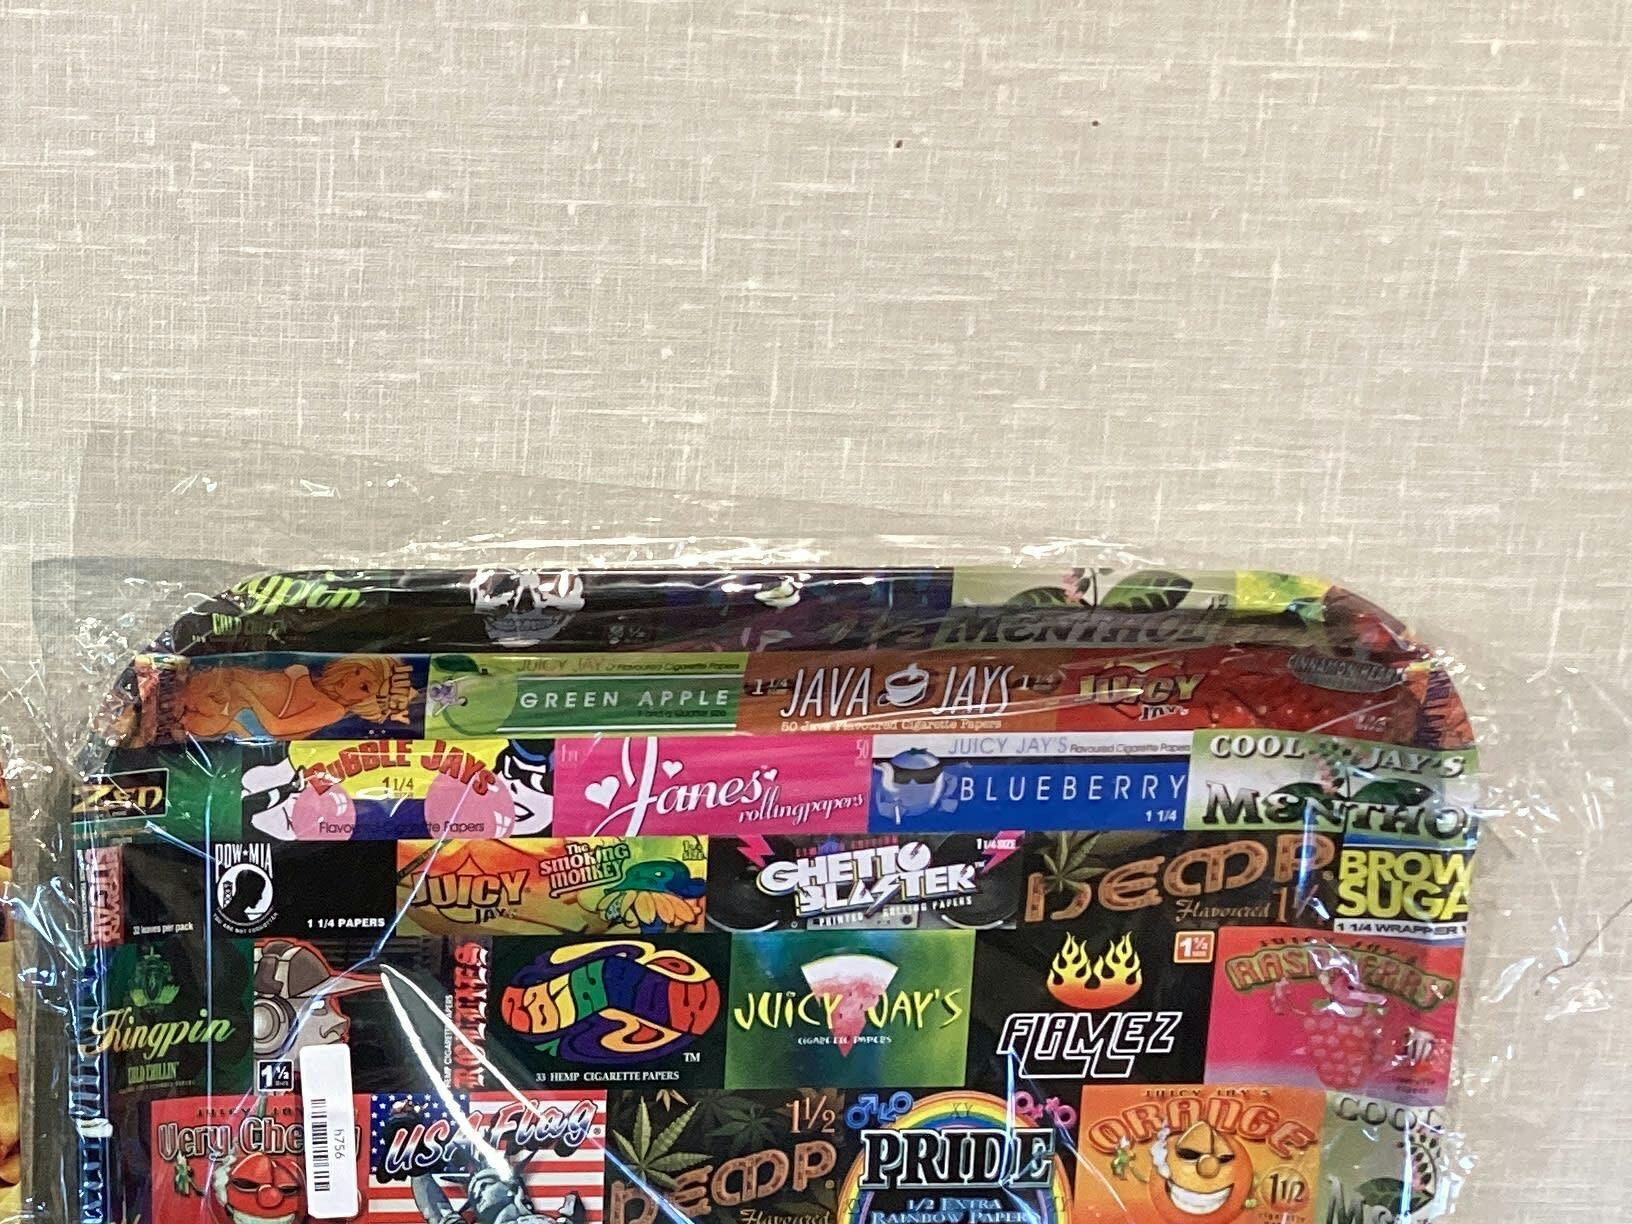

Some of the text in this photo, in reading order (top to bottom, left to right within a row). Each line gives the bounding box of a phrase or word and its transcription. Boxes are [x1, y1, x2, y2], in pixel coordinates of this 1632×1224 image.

[519, 689, 730, 709] GREEN APPLE
[779, 666, 873, 718] JAVA
[931, 664, 1015, 717] JAYS
[959, 718, 1003, 732] Papers
[947, 736, 1010, 757] JUICY
[1015, 735, 1068, 756] JAY'S
[1209, 734, 1306, 761] COOL
[420, 739, 497, 797] JAYS
[960, 774, 1187, 802] BLUEBERRY
[443, 820, 485, 836] Papers
[756, 841, 934, 896] GHETTO
[407, 868, 532, 907] JUICY
[932, 895, 973, 911] PAPERS
[175, 921, 195, 933] pack
[316, 917, 335, 930] 1/4
[336, 916, 386, 930] PAPERS
[1374, 922, 1459, 936] WRAPPER
[732, 988, 964, 1032] JUICY JAY'S
[78, 1006, 238, 1062] Kingpin
[549, 1071, 580, 1082] HEMP
[582, 1071, 642, 1083] CIGARETTE
[642, 1070, 680, 1083] PAPERS
[488, 1098, 601, 1149] Flag
[1088, 1096, 1318, 1160] ORANGE
[858, 1127, 1058, 1191] PRIDE
